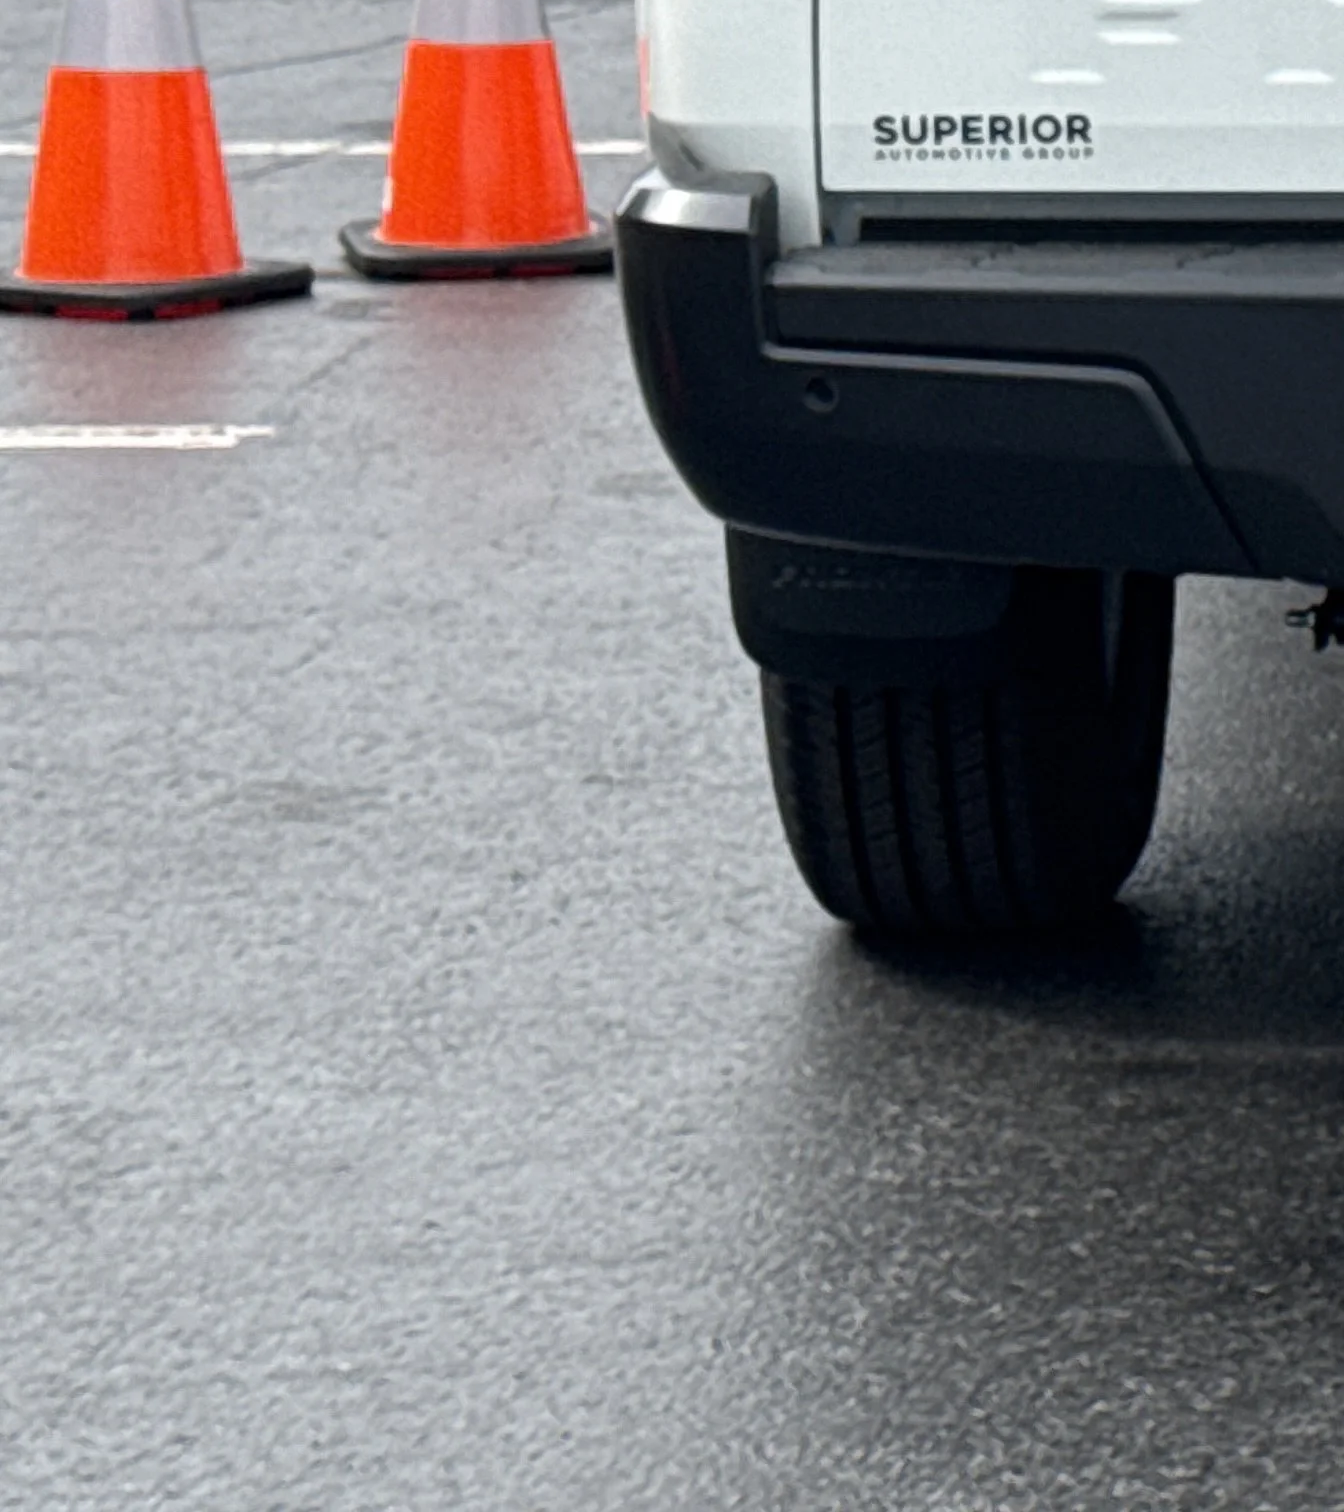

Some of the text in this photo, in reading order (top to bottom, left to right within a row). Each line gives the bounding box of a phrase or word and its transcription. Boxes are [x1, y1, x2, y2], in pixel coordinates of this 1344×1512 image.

[872, 113, 1093, 146] SUPERIOR
[874, 147, 1094, 161] AUTOMOTIVE GROUP
